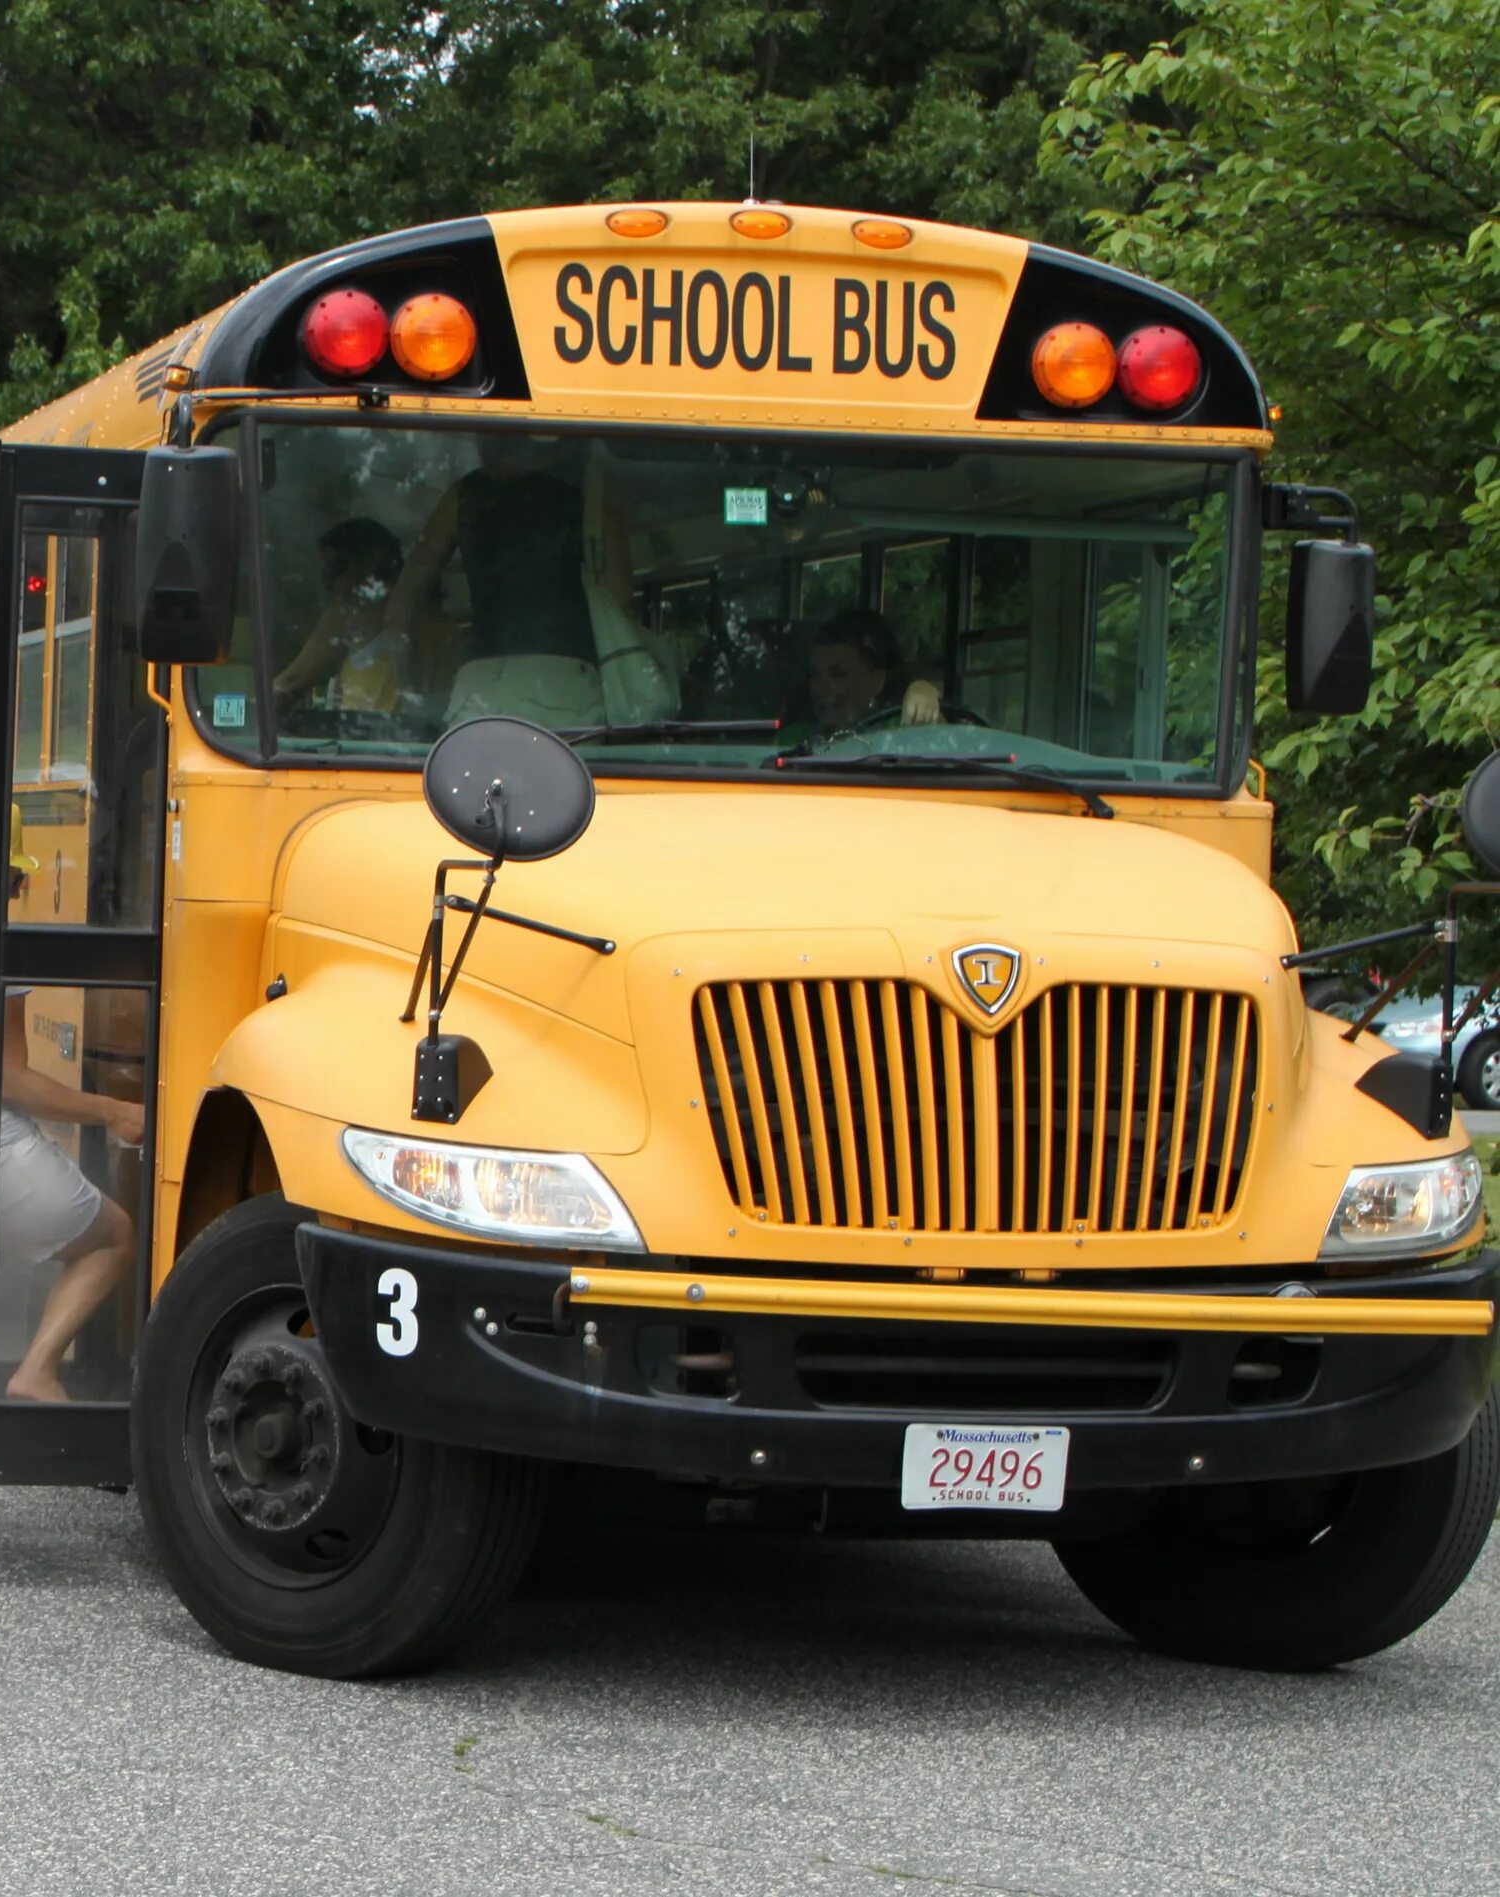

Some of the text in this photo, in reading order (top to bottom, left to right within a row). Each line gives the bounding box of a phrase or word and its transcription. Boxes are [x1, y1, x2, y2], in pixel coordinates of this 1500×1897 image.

[554, 262, 957, 381] SCHOOL BUS
[54, 848, 62, 915] 3
[376, 1267, 419, 1357] 3
[942, 1429, 1034, 1444] Massachusetts
[929, 1447, 1044, 1490] 29496
[939, 1490, 1025, 1502] SCHOOL BUS
